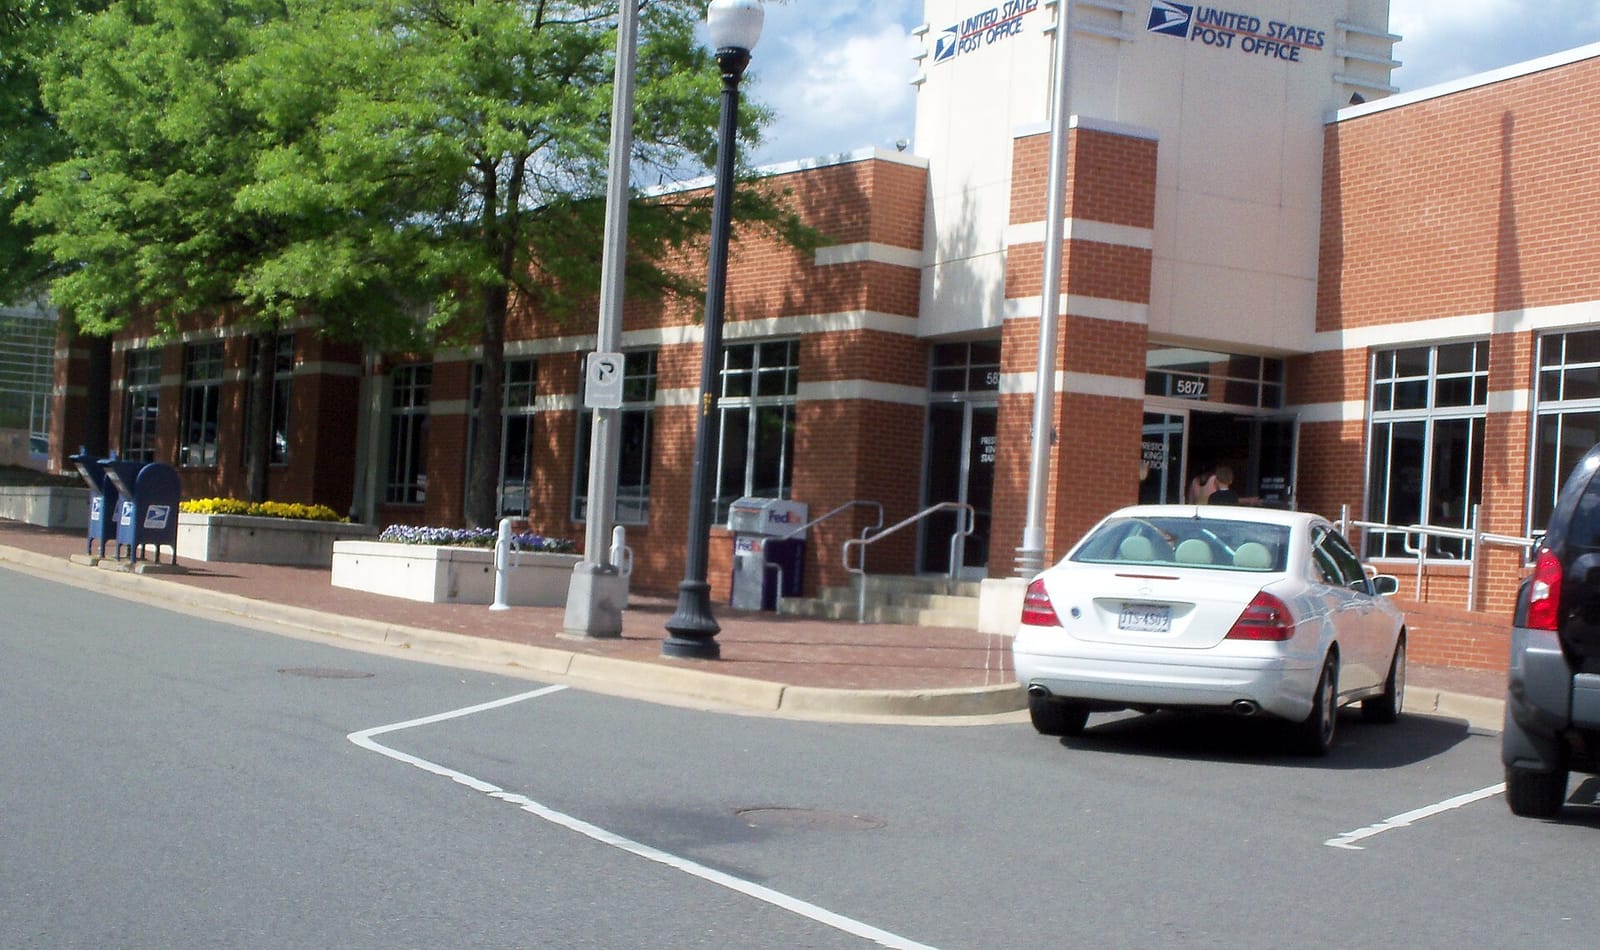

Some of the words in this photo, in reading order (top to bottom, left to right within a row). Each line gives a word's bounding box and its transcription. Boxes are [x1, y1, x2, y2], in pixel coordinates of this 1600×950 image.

[957, 32, 983, 56] POST
[986, 16, 1023, 45] OFFICE
[961, 8, 998, 35] UNITED
[1195, 6, 1260, 33] UNITED
[1266, 21, 1325, 47] STATES
[1190, 26, 1236, 49] POST
[1241, 36, 1301, 62] OFFICE
[985, 371, 999, 385] 58
[1176, 380, 1205, 395] 5877
